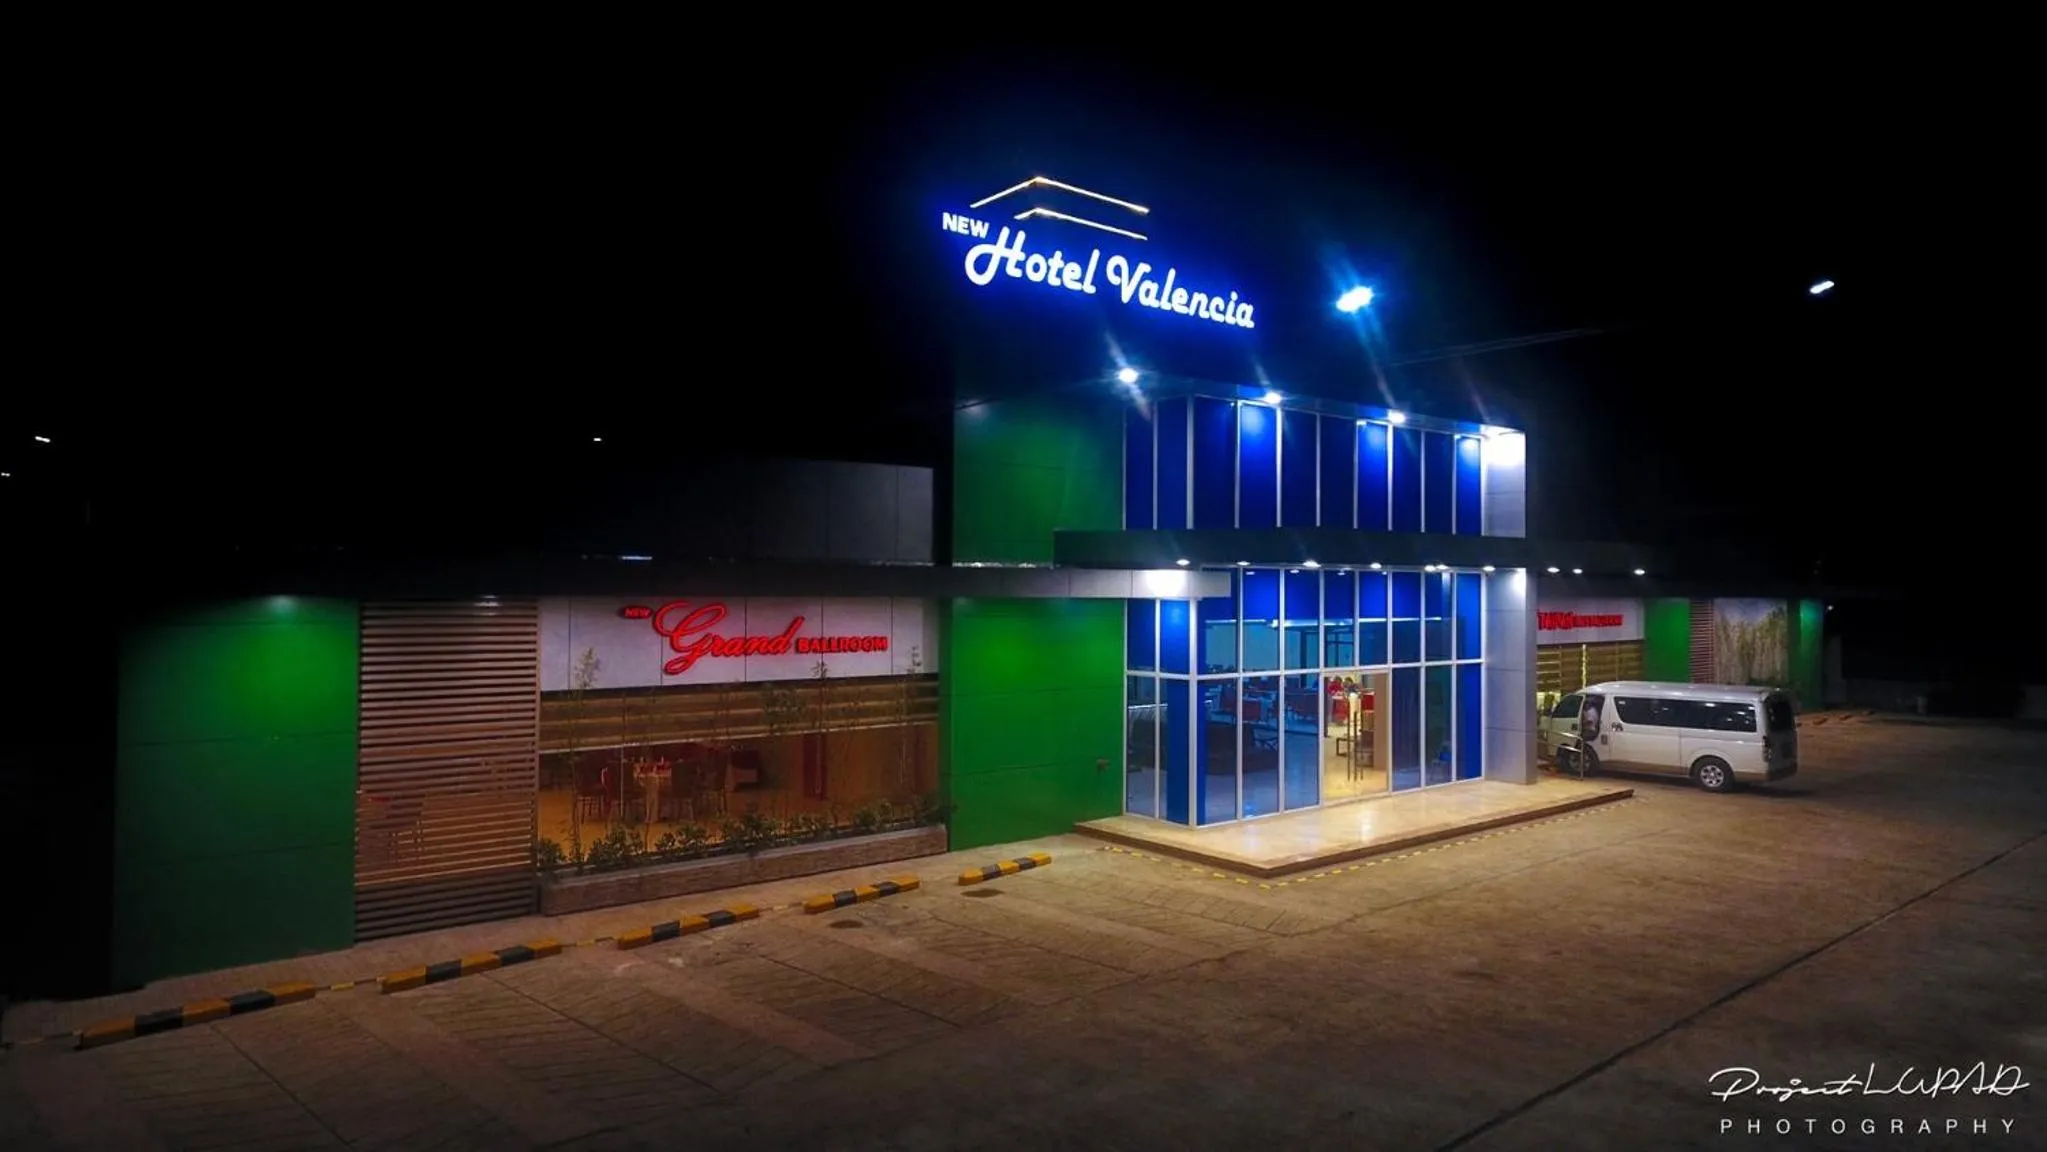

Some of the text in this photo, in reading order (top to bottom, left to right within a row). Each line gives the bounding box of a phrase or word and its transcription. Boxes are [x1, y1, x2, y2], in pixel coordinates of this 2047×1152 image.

[942, 212, 989, 238] NEW
[965, 227, 1255, 328] Hotel Valencia
[653, 600, 805, 675] Grand
[796, 636, 889, 654] BALLROOM
